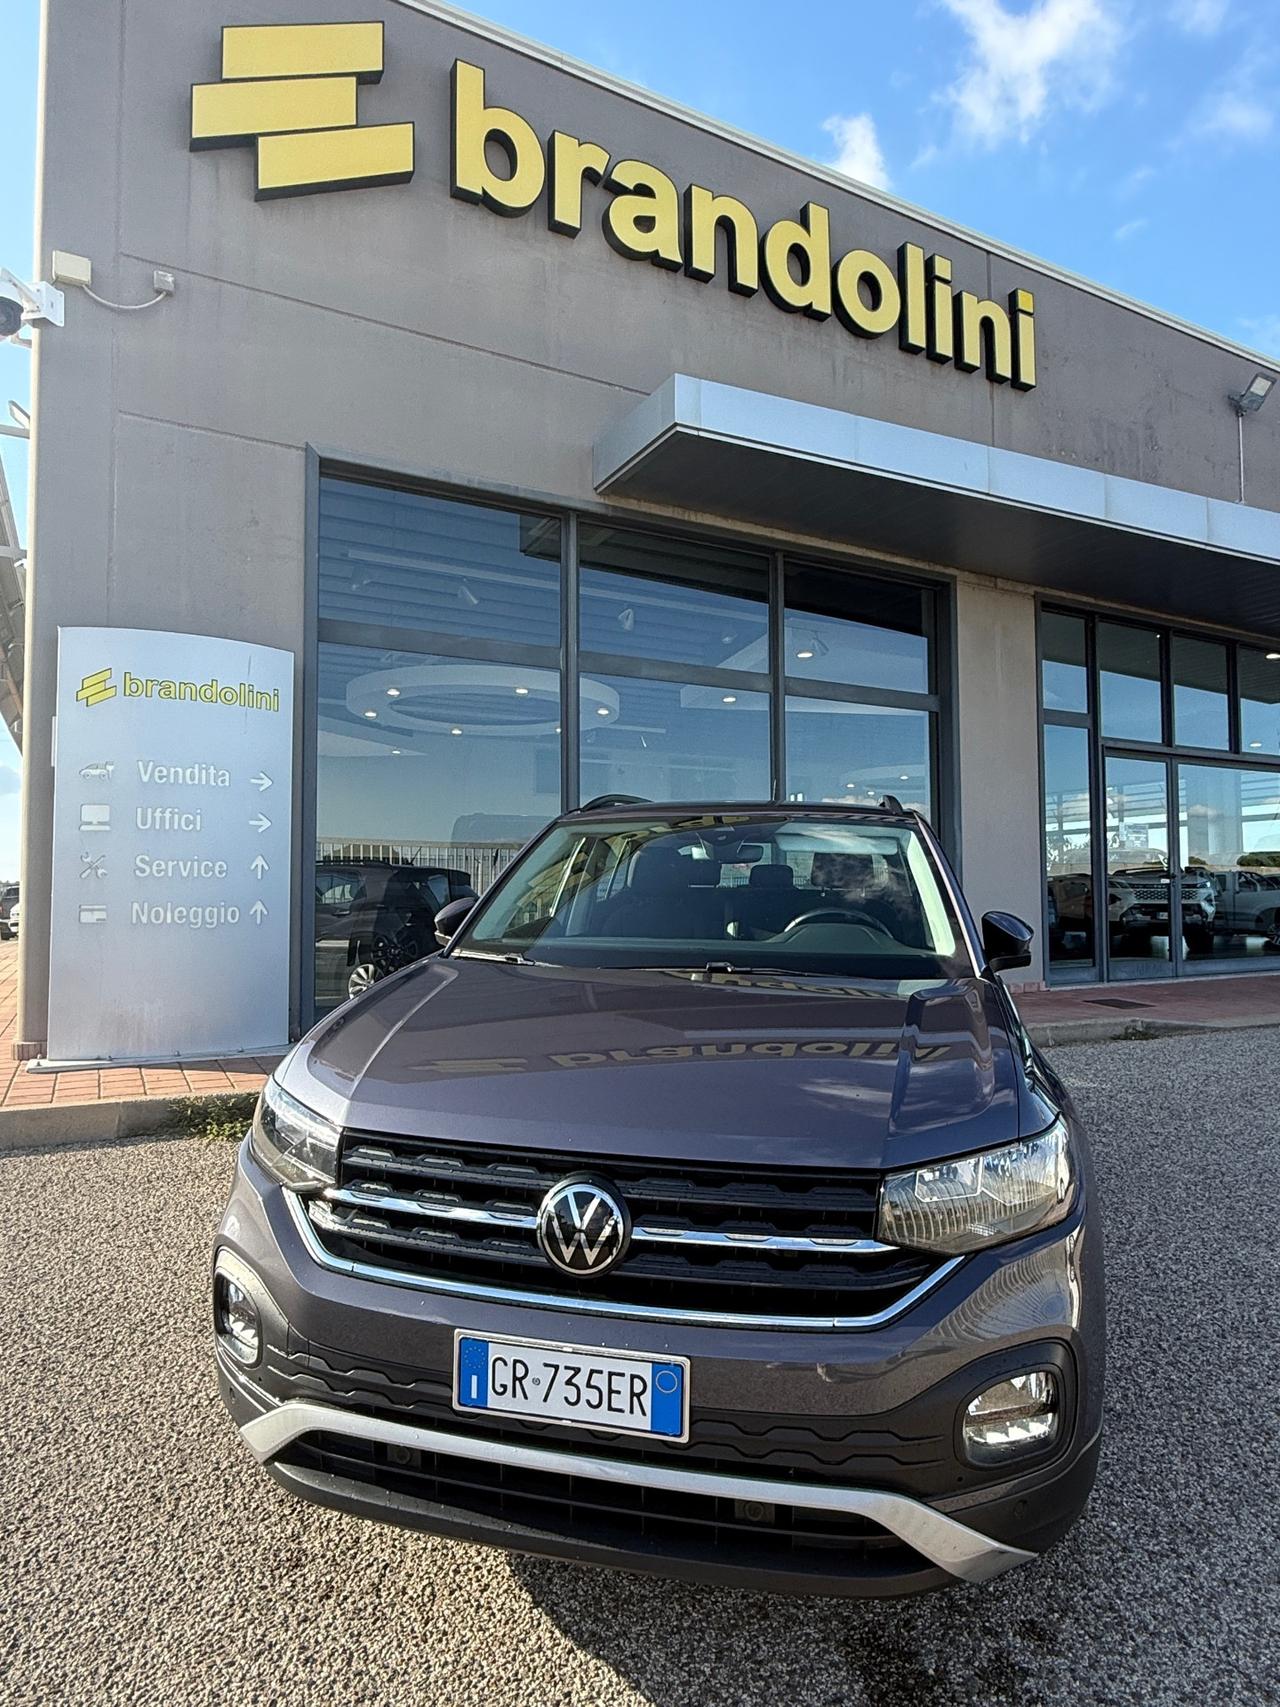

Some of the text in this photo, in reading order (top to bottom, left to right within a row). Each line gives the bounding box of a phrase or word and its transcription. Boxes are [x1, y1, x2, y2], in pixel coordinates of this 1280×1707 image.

[450, 57, 1038, 391] brandolini
[123, 672, 280, 712] brandolini
[137, 760, 231, 787] Vendita
[135, 807, 202, 831] Uffici
[134, 855, 228, 878] Service
[131, 902, 240, 929] Noleggio
